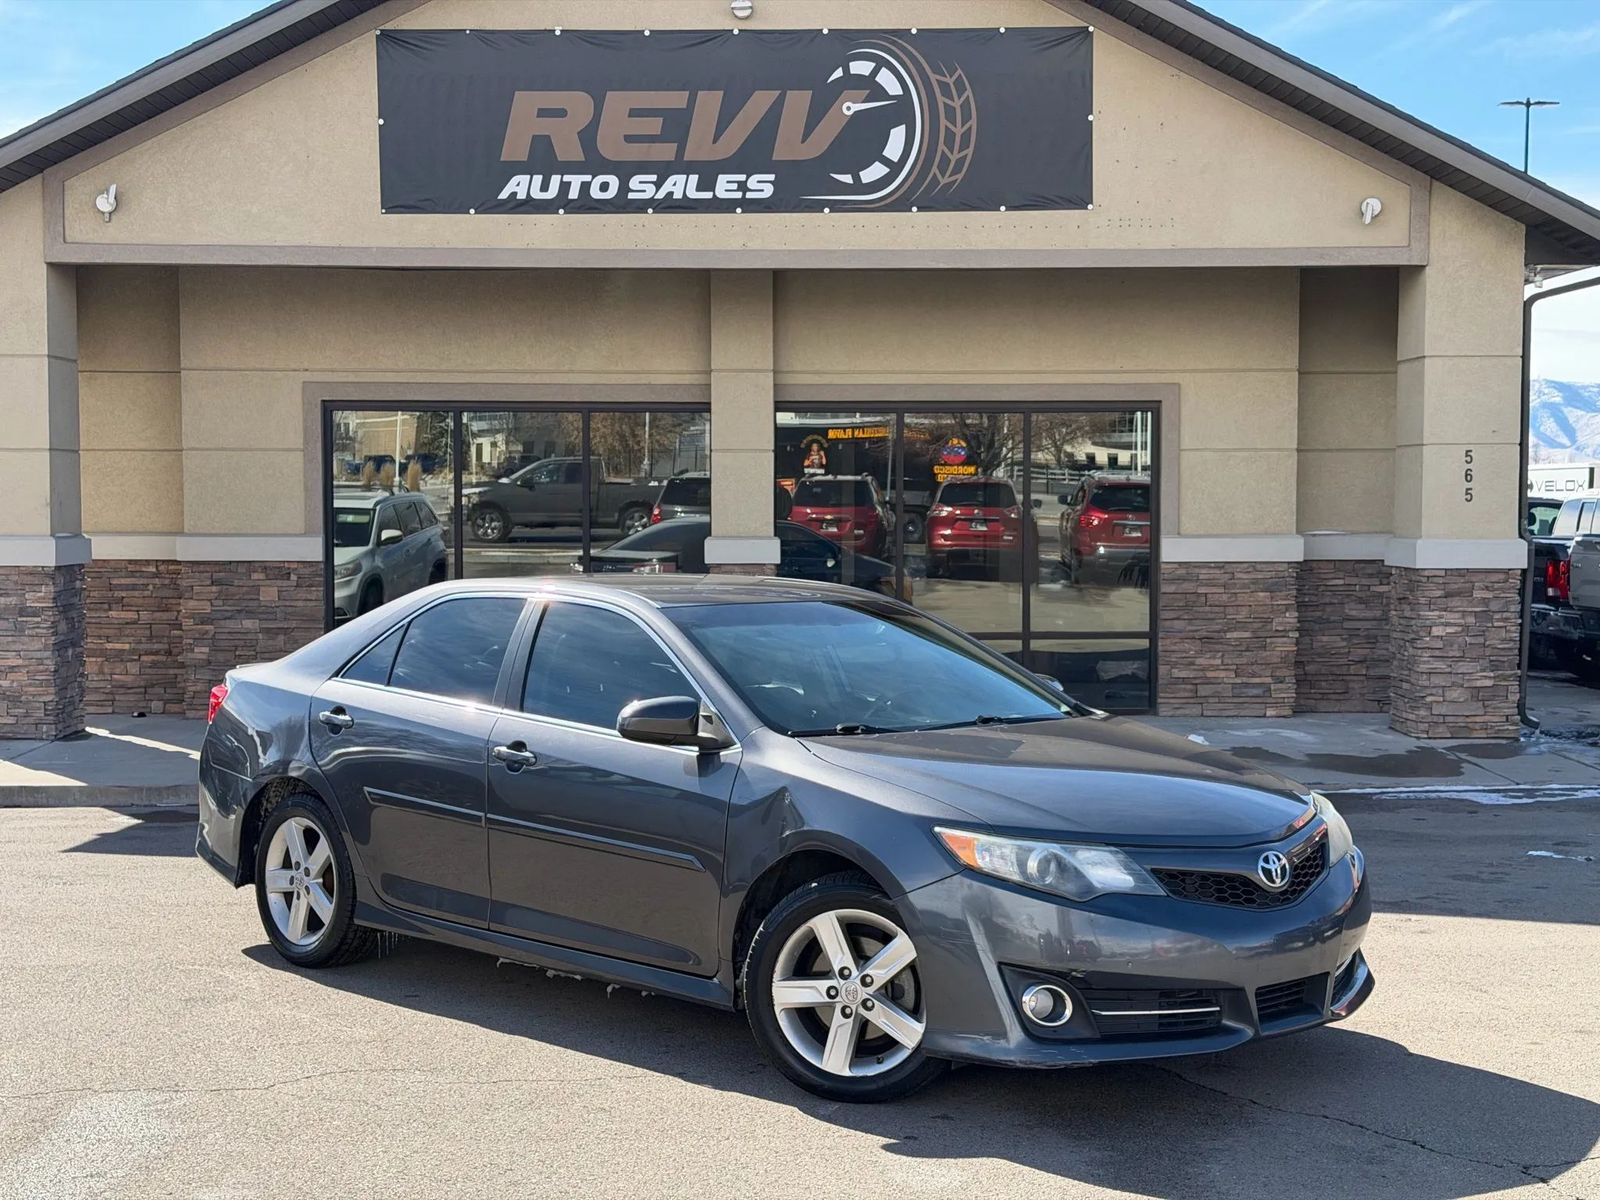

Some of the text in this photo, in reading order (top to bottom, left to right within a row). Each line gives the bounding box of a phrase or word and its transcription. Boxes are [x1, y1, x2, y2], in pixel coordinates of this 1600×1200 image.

[500, 90, 870, 162] REVV
[497, 174, 776, 200] AUTO SALES
[1464, 449, 1474, 503] 565
[1535, 479, 1586, 493] VELOX
